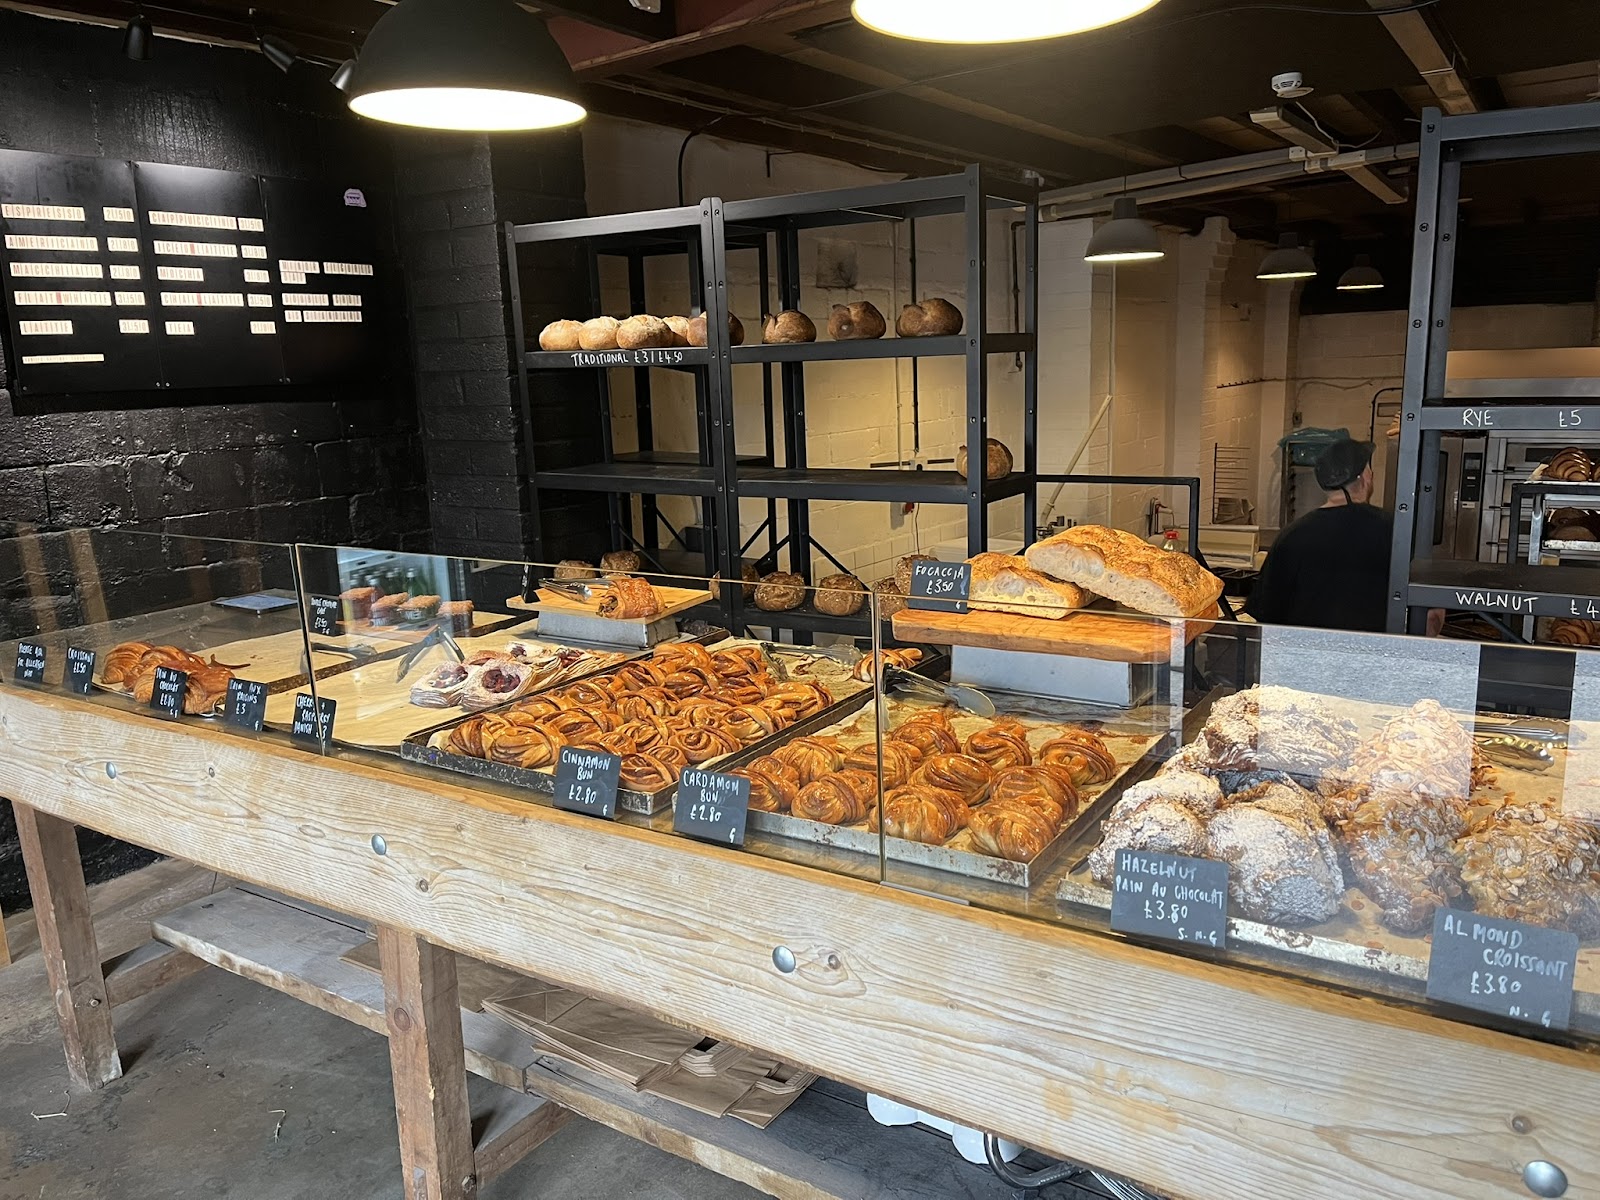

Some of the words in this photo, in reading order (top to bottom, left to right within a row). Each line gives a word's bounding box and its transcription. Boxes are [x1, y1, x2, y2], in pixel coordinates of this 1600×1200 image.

[3, 205, 83, 219] ESPRESSO
[150, 212, 236, 229] CAPPUCCINO
[7, 236, 96, 249] AMERICANO
[196, 244, 235, 256] LATTE
[12, 263, 101, 277] MACCHIATO
[158, 267, 201, 280] MOCHA
[17, 292, 54, 304] FLAT
[61, 292, 109, 305] WHITE
[163, 293, 195, 305] CHAI
[202, 294, 242, 306] LATTE
[22, 322, 71, 334] LATTE
[168, 322, 192, 334] TEA
[571, 353, 629, 367] TRADITIONAL
[658, 351, 683, 364] £4.50
[1462, 408, 1494, 427] RYE
[1558, 408, 1582, 427] £5
[915, 565, 964, 580] FOCACCIA
[926, 578, 954, 595] £3.50
[1455, 591, 1539, 613] WALNUT
[67, 647, 95, 666] CROISSANT
[159, 680, 179, 693] CHOCOLAT
[249, 682, 262, 695] AUX
[236, 691, 258, 704] RAISINS
[296, 695, 316, 711] CHERR
[235, 702, 246, 715] £3
[301, 709, 330, 724] RASPRRY
[562, 749, 611, 770] CINNAMON
[577, 768, 593, 781] BUN
[683, 771, 740, 796] CARDAMOM
[568, 784, 597, 804] £2.80
[700, 790, 719, 803] BUN
[690, 804, 722, 823] £2.80
[1122, 853, 1197, 882] HAZELNUT
[1115, 874, 1143, 893] PAIN
[1151, 881, 1167, 898] AU
[1174, 884, 1223, 910] CHOCOLAT
[1143, 899, 1188, 924] £3.80
[1444, 914, 1523, 950] ALMOND
[1482, 948, 1568, 982] CROISSANT
